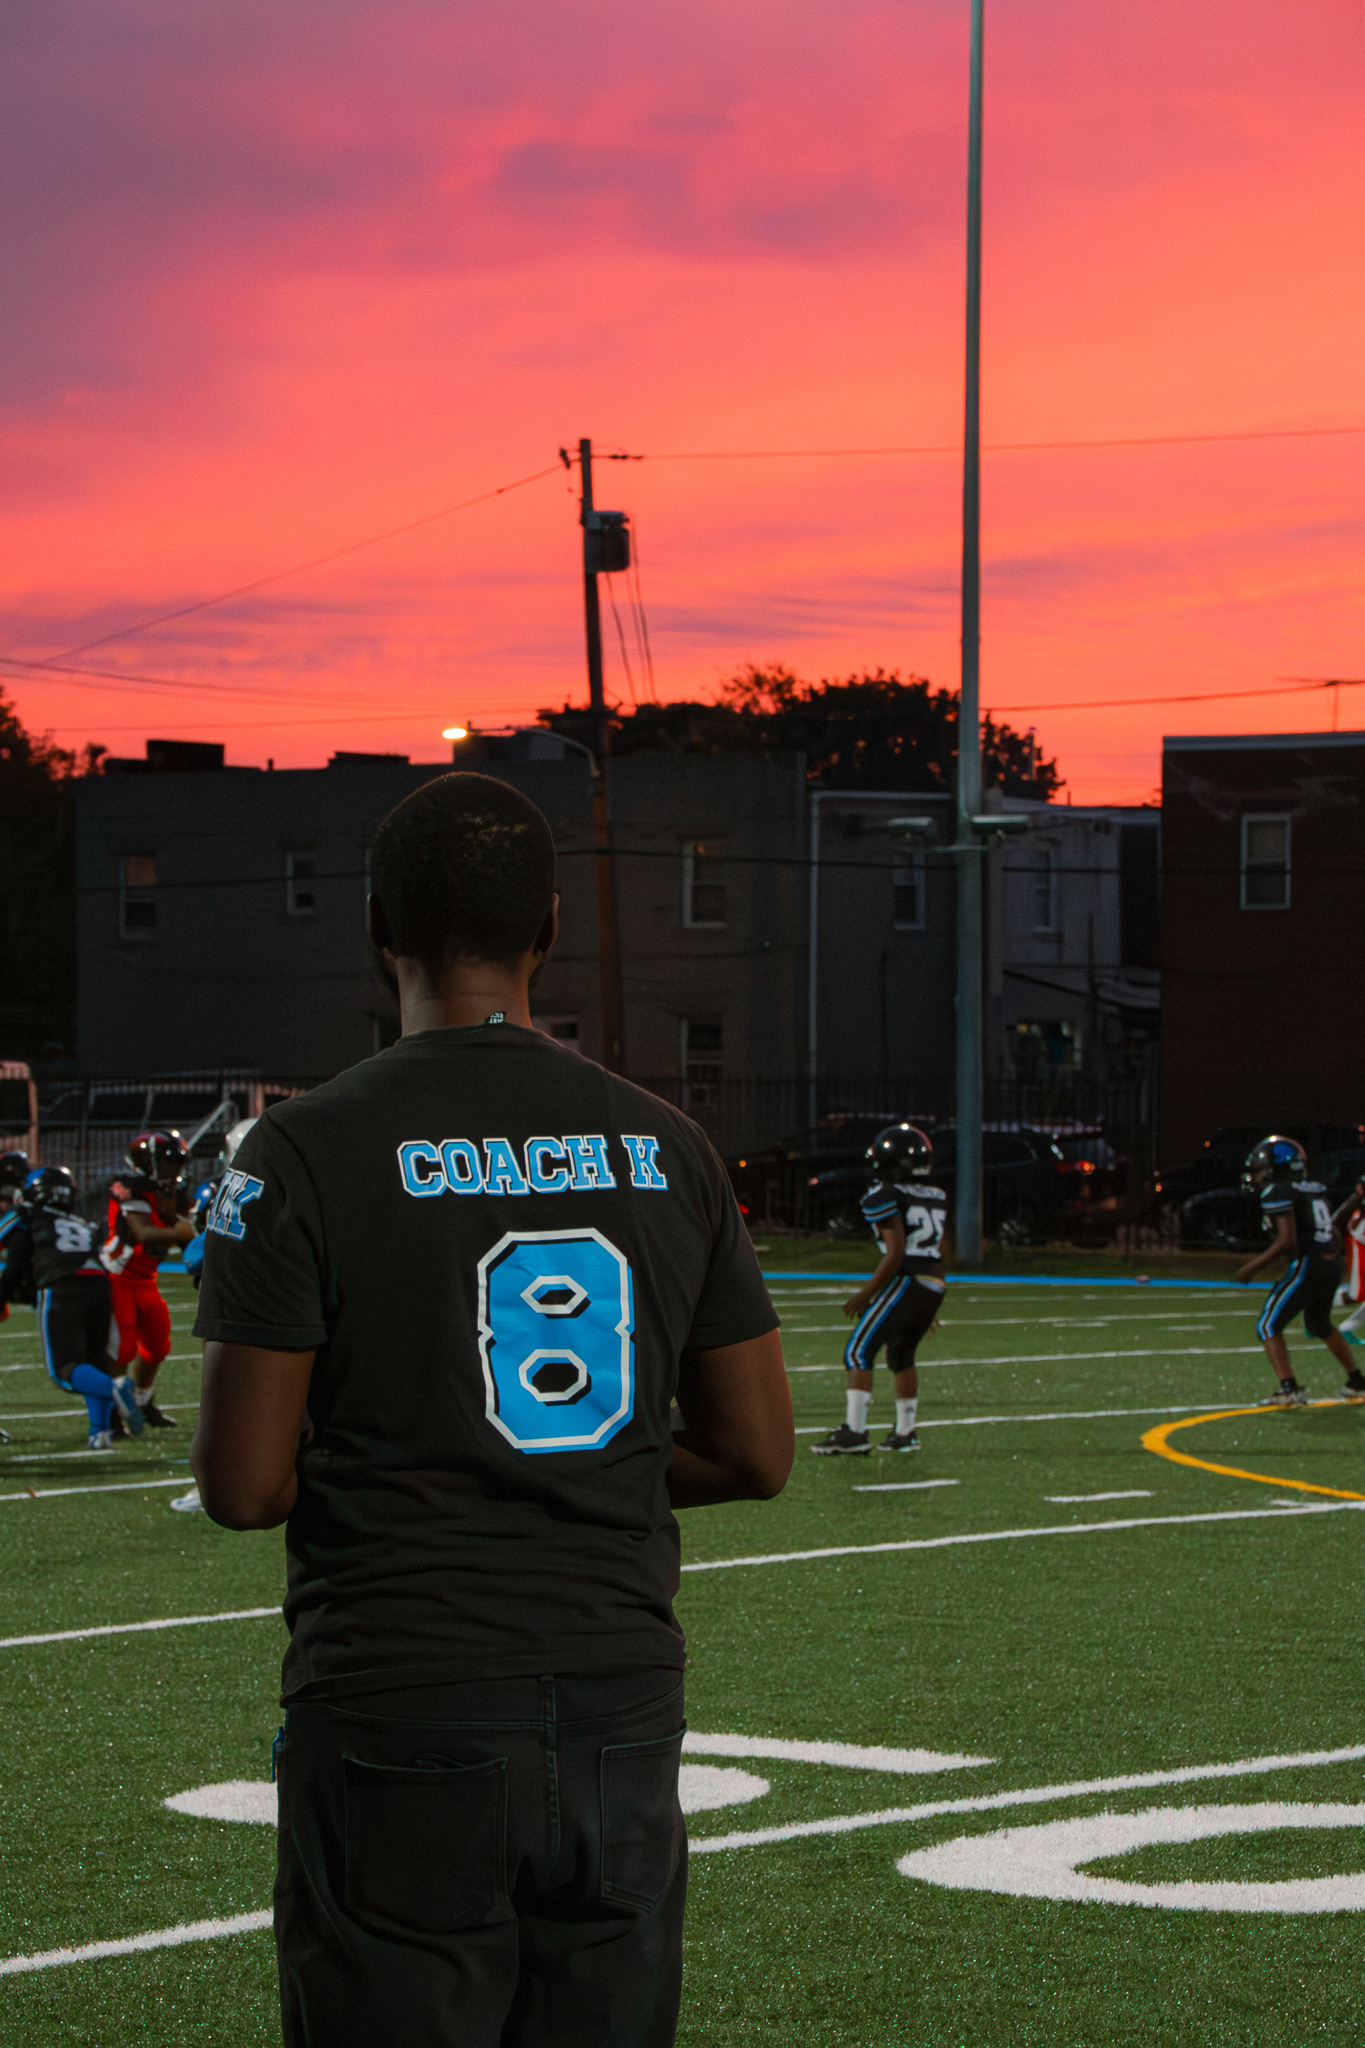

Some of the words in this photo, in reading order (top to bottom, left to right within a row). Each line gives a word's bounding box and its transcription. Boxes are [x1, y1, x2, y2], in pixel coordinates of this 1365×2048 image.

[397, 1136, 616, 1197] COACH
[621, 1135, 668, 1190] K
[477, 1228, 635, 1454] 8
